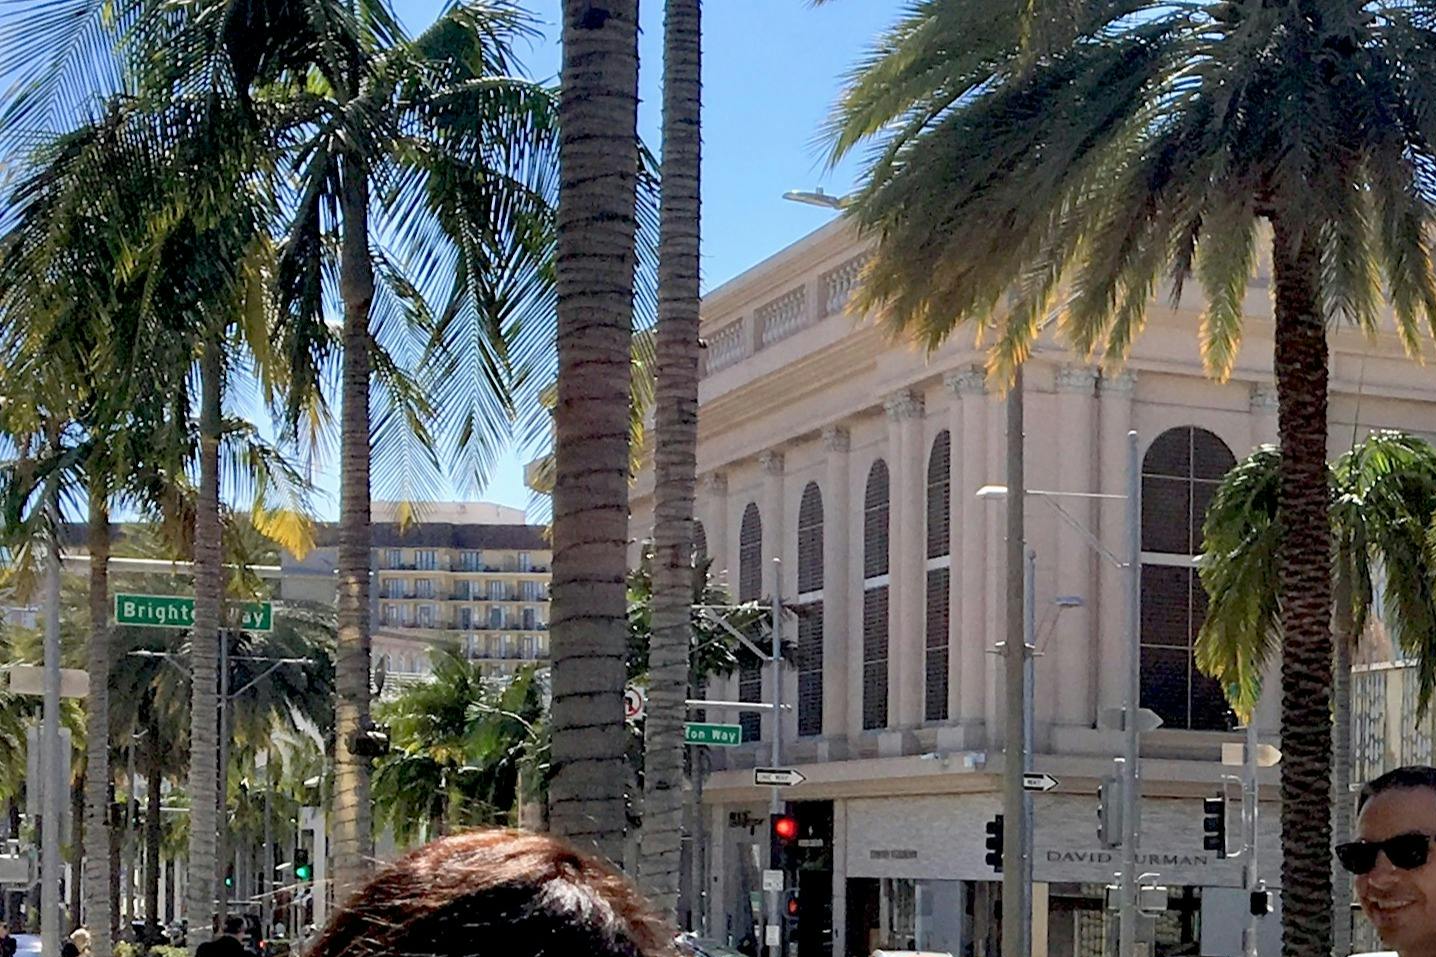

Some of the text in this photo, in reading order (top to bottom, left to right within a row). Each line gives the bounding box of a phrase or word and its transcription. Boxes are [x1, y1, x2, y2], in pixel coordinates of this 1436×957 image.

[123, 601, 195, 624] Bright
[711, 729, 736, 743] Way
[1047, 851, 1207, 866] DAVID URMAN
